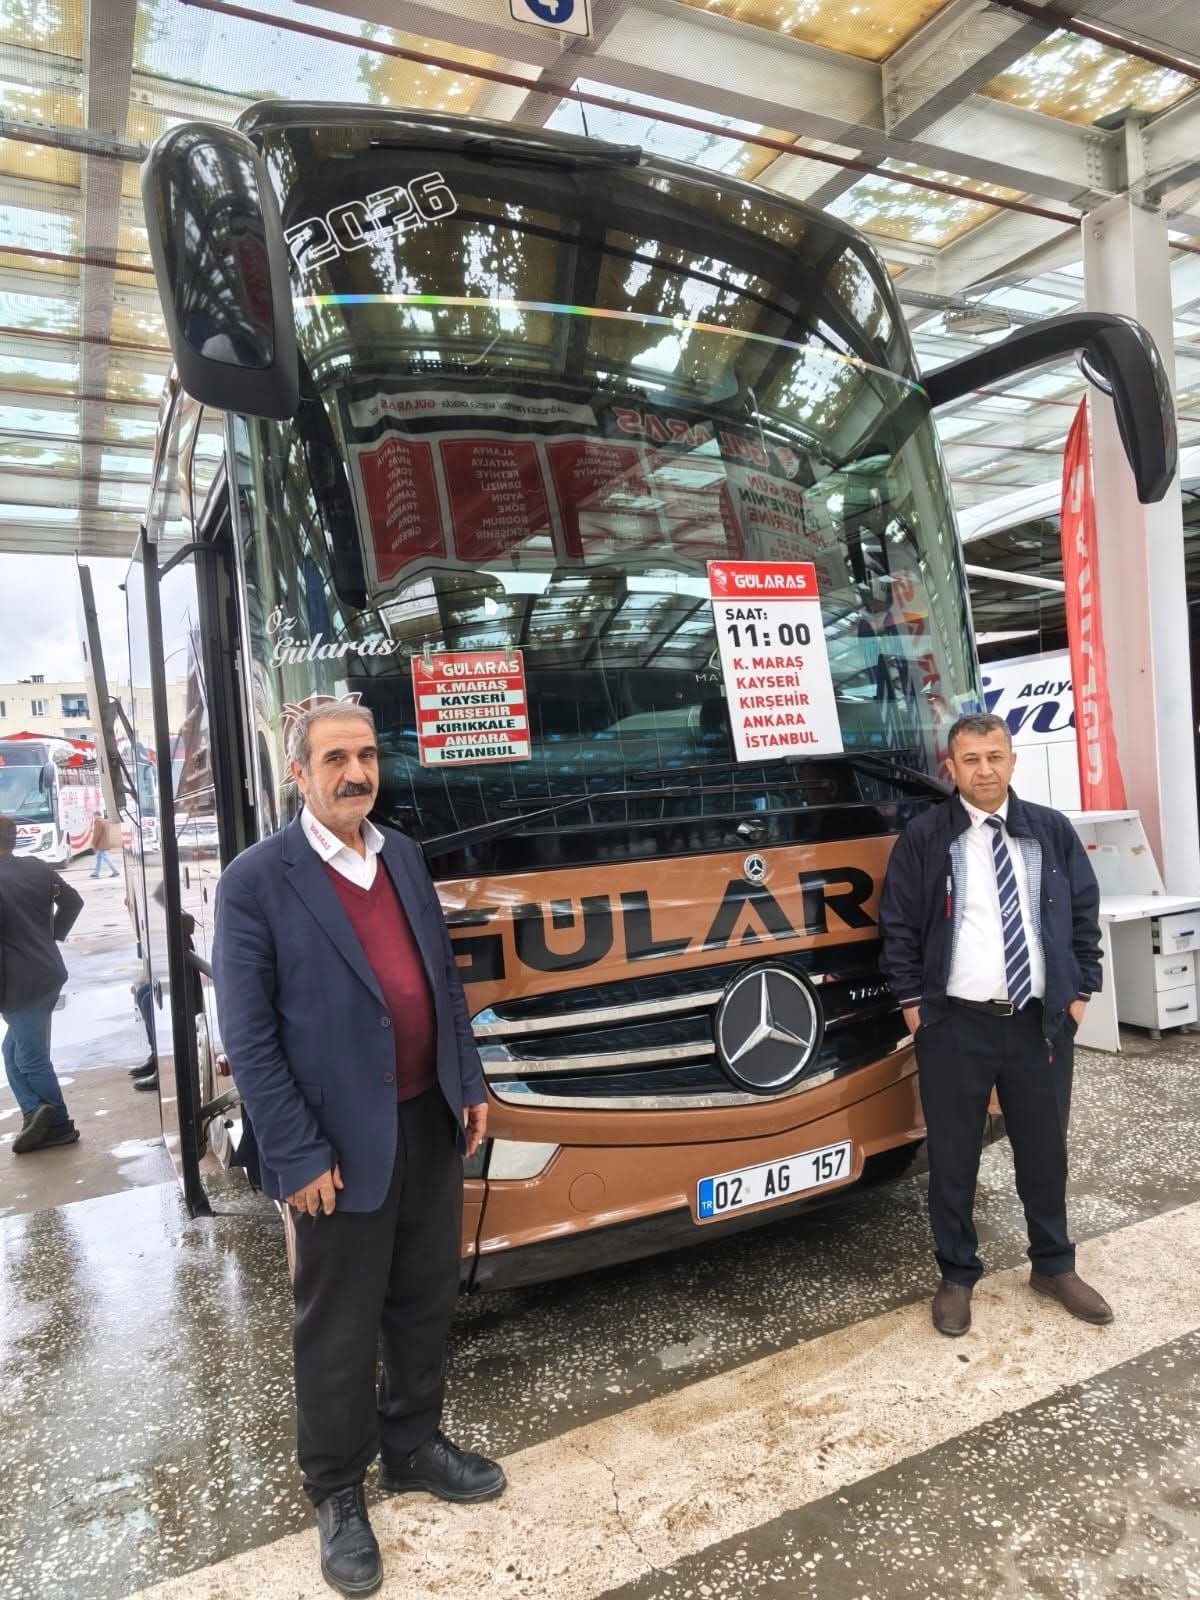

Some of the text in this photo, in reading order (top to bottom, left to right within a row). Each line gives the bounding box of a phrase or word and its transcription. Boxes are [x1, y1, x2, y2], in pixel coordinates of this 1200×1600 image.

[283, 171, 458, 273] 2026
[734, 574, 807, 589] GÜLARAS
[265, 604, 298, 634] Öz
[725, 608, 768, 621] SAAT:
[270, 633, 400, 669] Gülaras
[442, 660, 520, 677] GÜLARAS
[733, 655, 804, 671] K. MARAŞ
[436, 680, 508, 693] K.MARAŞ
[736, 672, 800, 689] KAYSERİ
[440, 691, 506, 706] KAYSERİ
[739, 691, 809, 710] KIRŞEHİR
[436, 718, 516, 734] KIRIKKALE
[743, 712, 805, 729] ANKARA
[445, 733, 510, 746] ANKARA
[745, 731, 819, 748] İSTANBUL
[440, 745, 516, 760] İSTANBUL
[715, 1148, 846, 1210] 02 AG 157
[701, 1200, 713, 1211] TR
